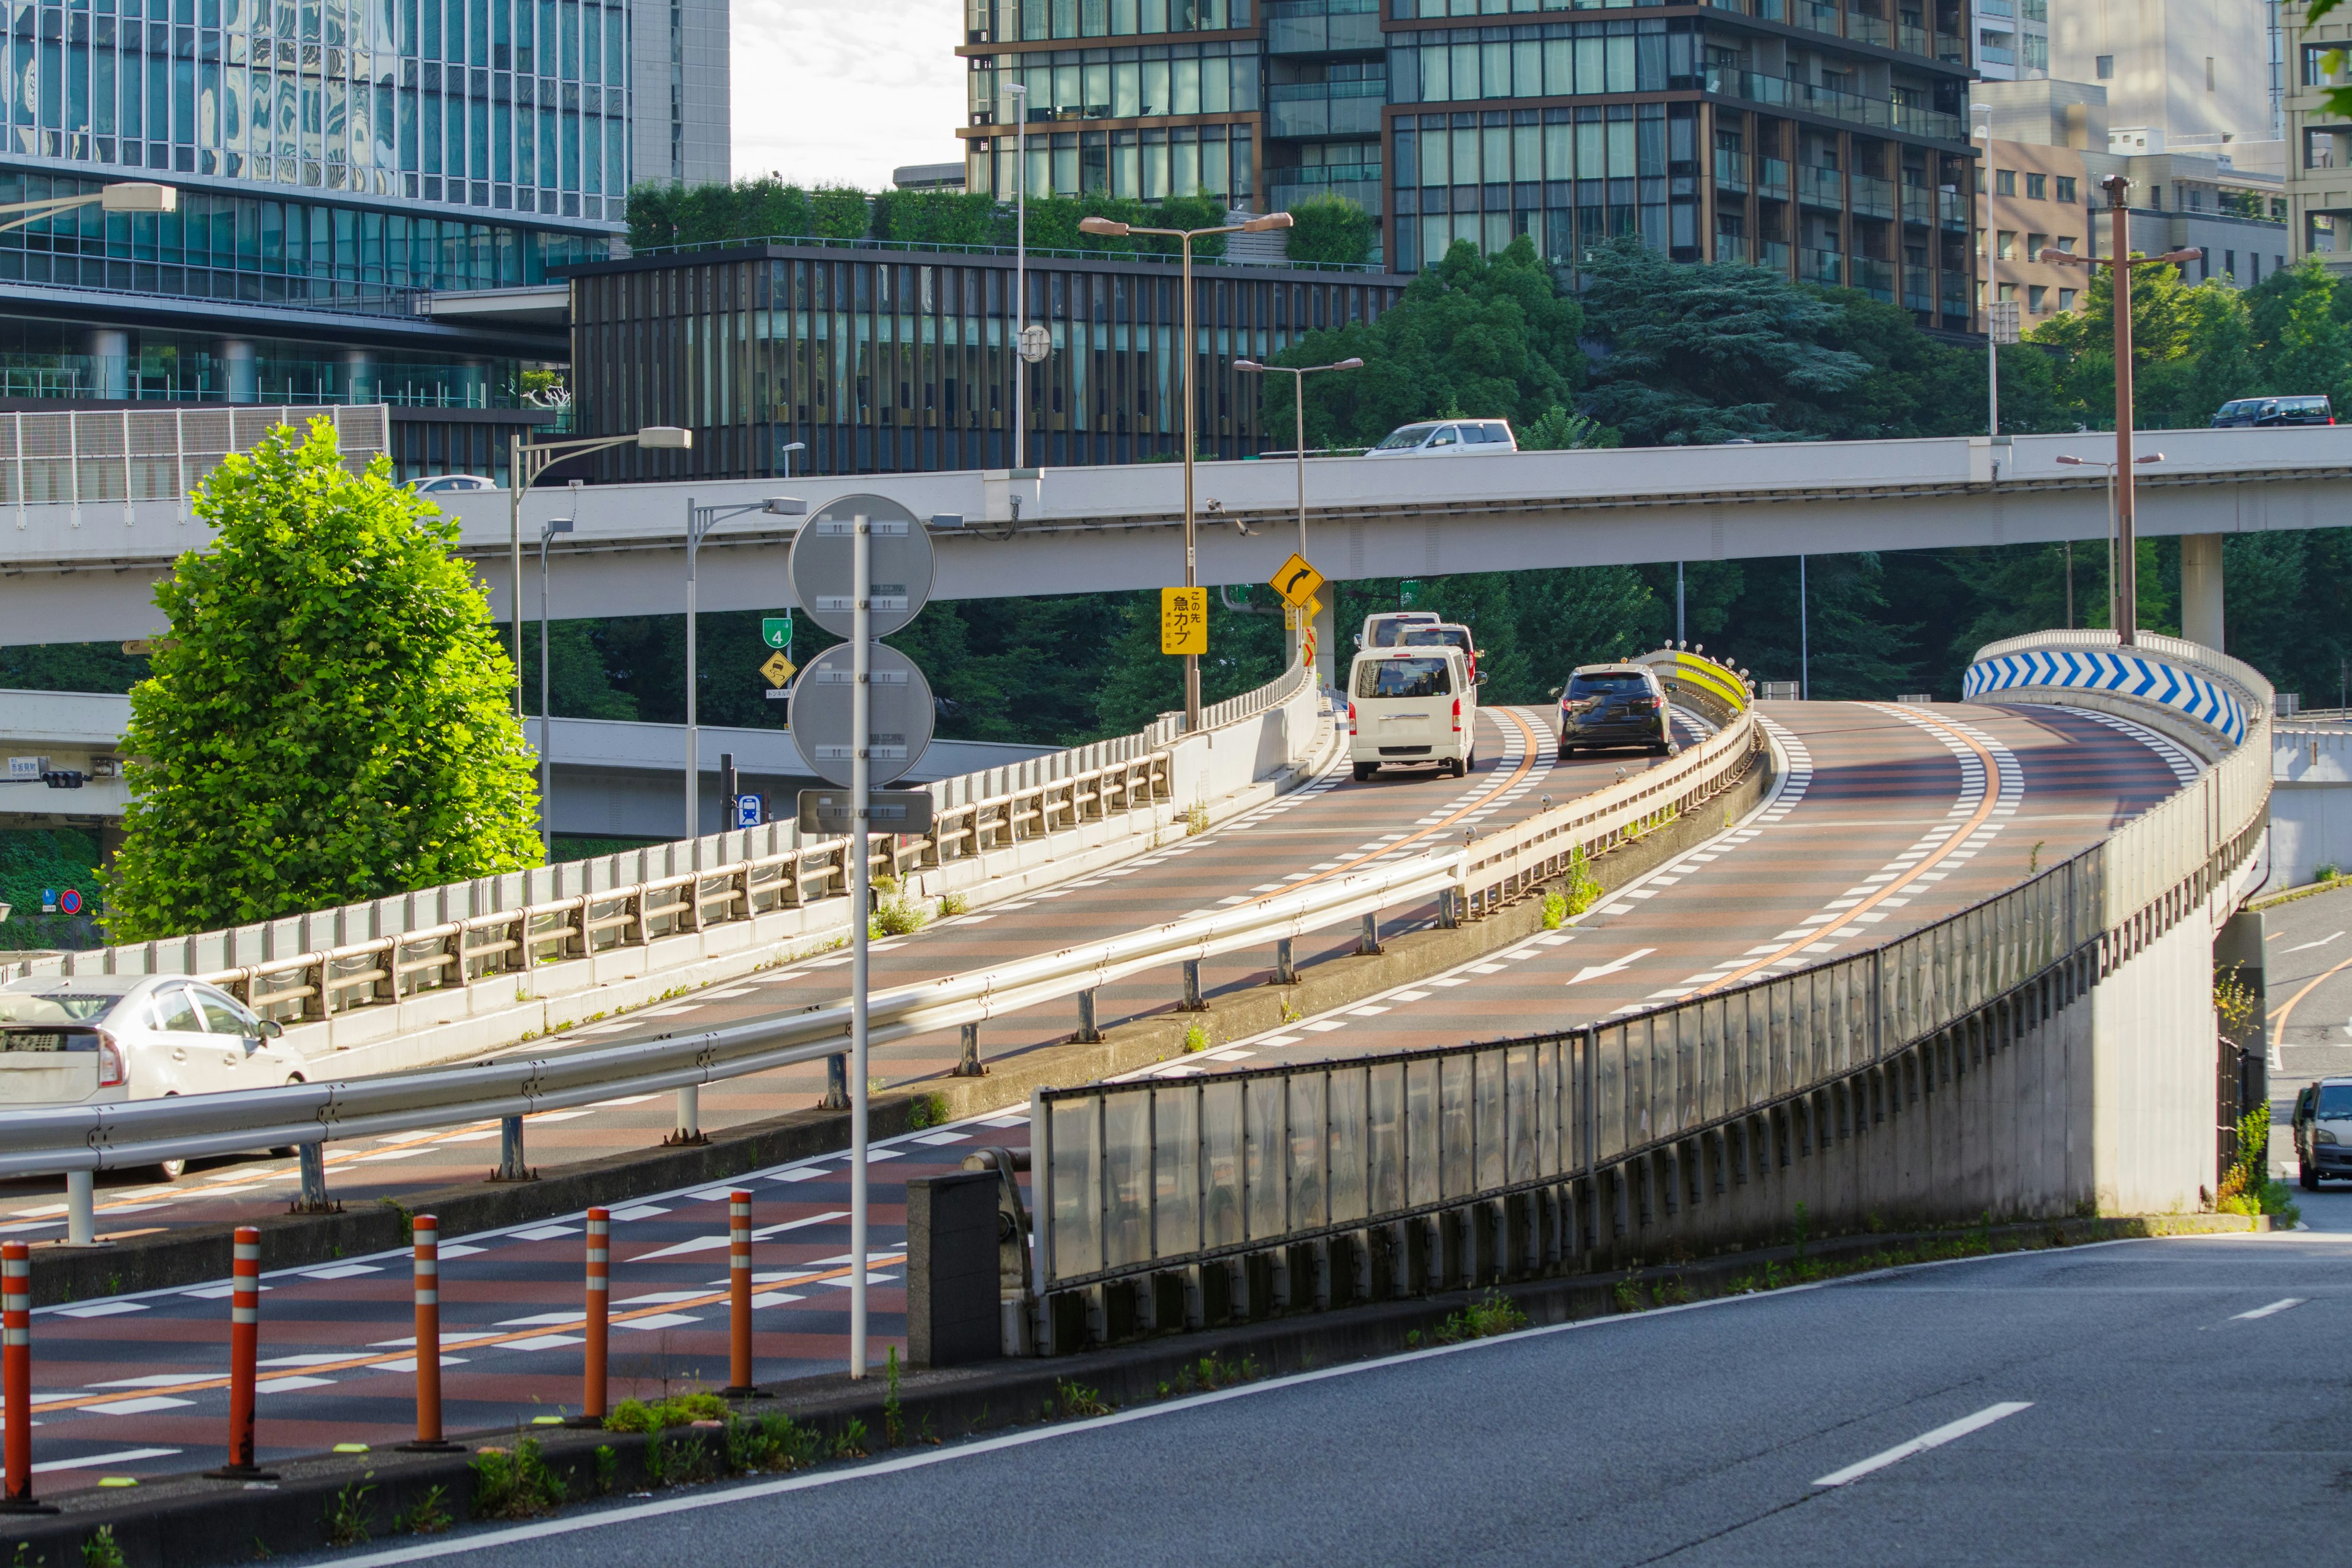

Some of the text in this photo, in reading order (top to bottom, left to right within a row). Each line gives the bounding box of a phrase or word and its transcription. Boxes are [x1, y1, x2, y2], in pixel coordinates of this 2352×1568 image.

[1174, 595, 1191, 645] 急カーブ
[1191, 592, 1200, 623] この先
[772, 630, 783, 644] 4
